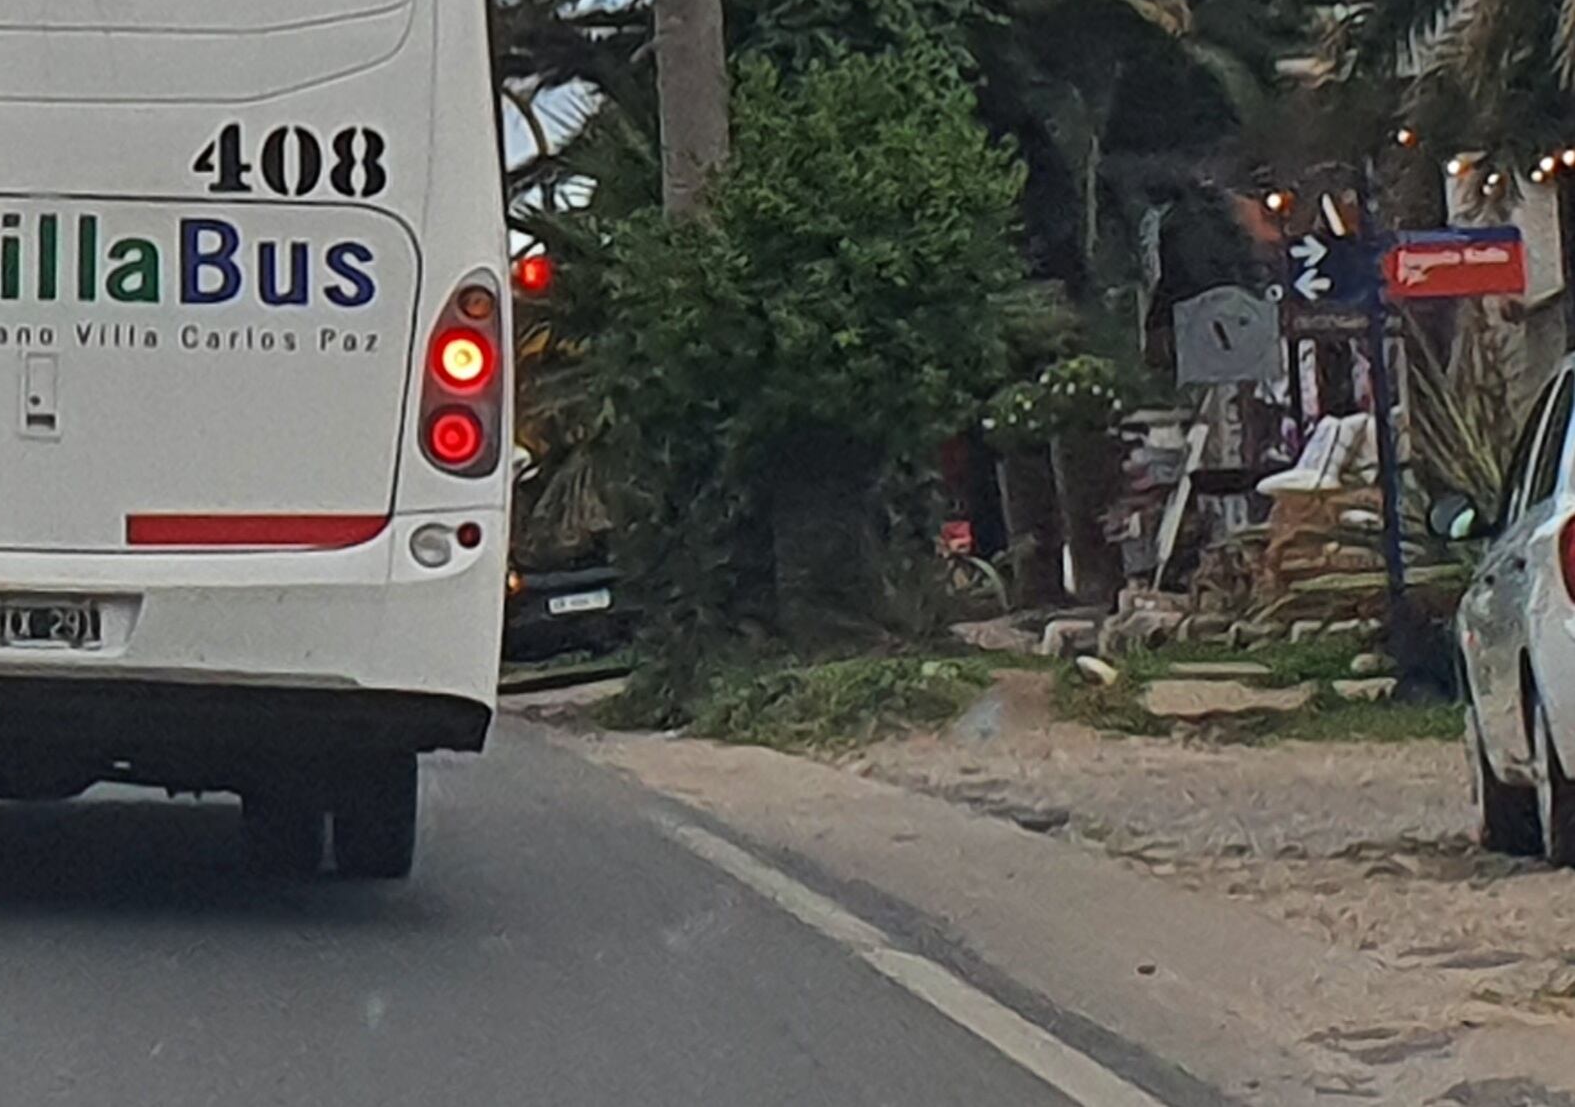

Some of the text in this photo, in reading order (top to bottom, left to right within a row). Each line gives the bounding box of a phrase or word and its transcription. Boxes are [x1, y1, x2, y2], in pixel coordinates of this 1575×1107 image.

[192, 121, 388, 198] 408
[76, 323, 159, 348] Villa
[181, 324, 297, 352] Carlos
